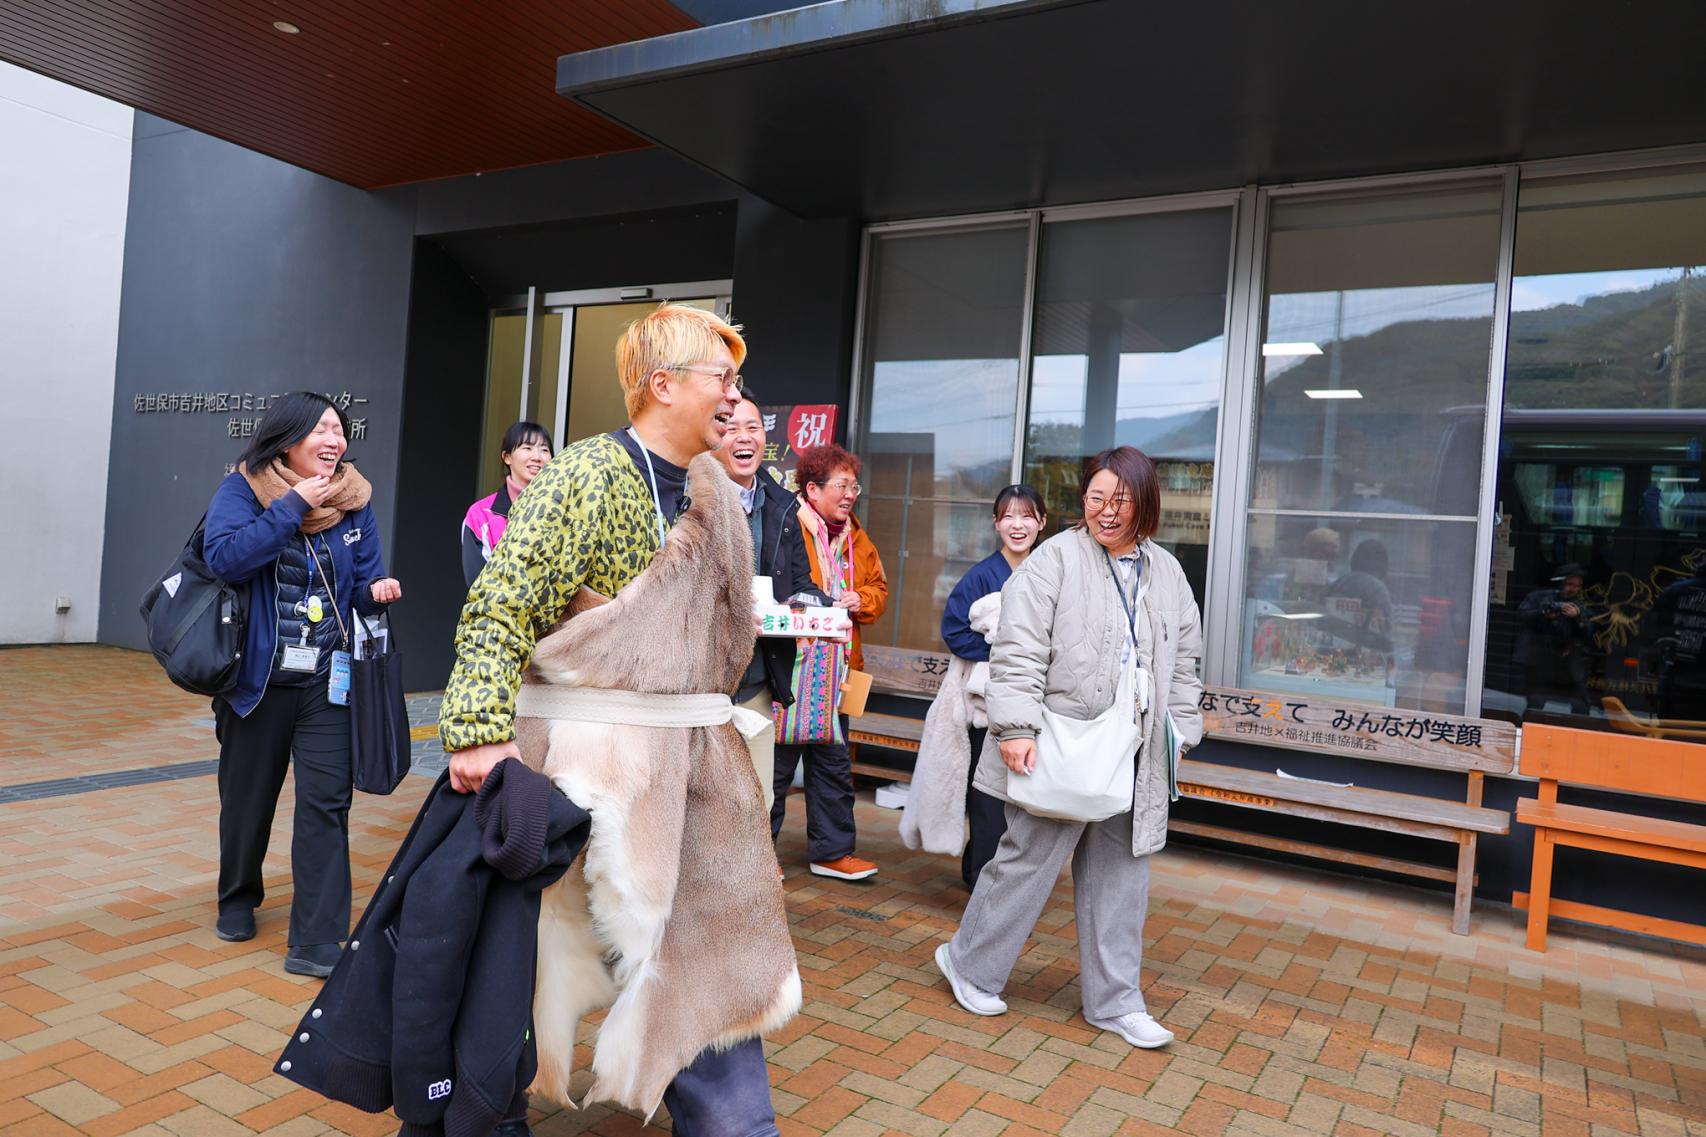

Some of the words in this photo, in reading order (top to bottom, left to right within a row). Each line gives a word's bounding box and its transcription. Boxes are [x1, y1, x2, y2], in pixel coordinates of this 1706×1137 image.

[794, 413, 828, 449] 祝
[1332, 709, 1482, 748] みんなが笑顔
